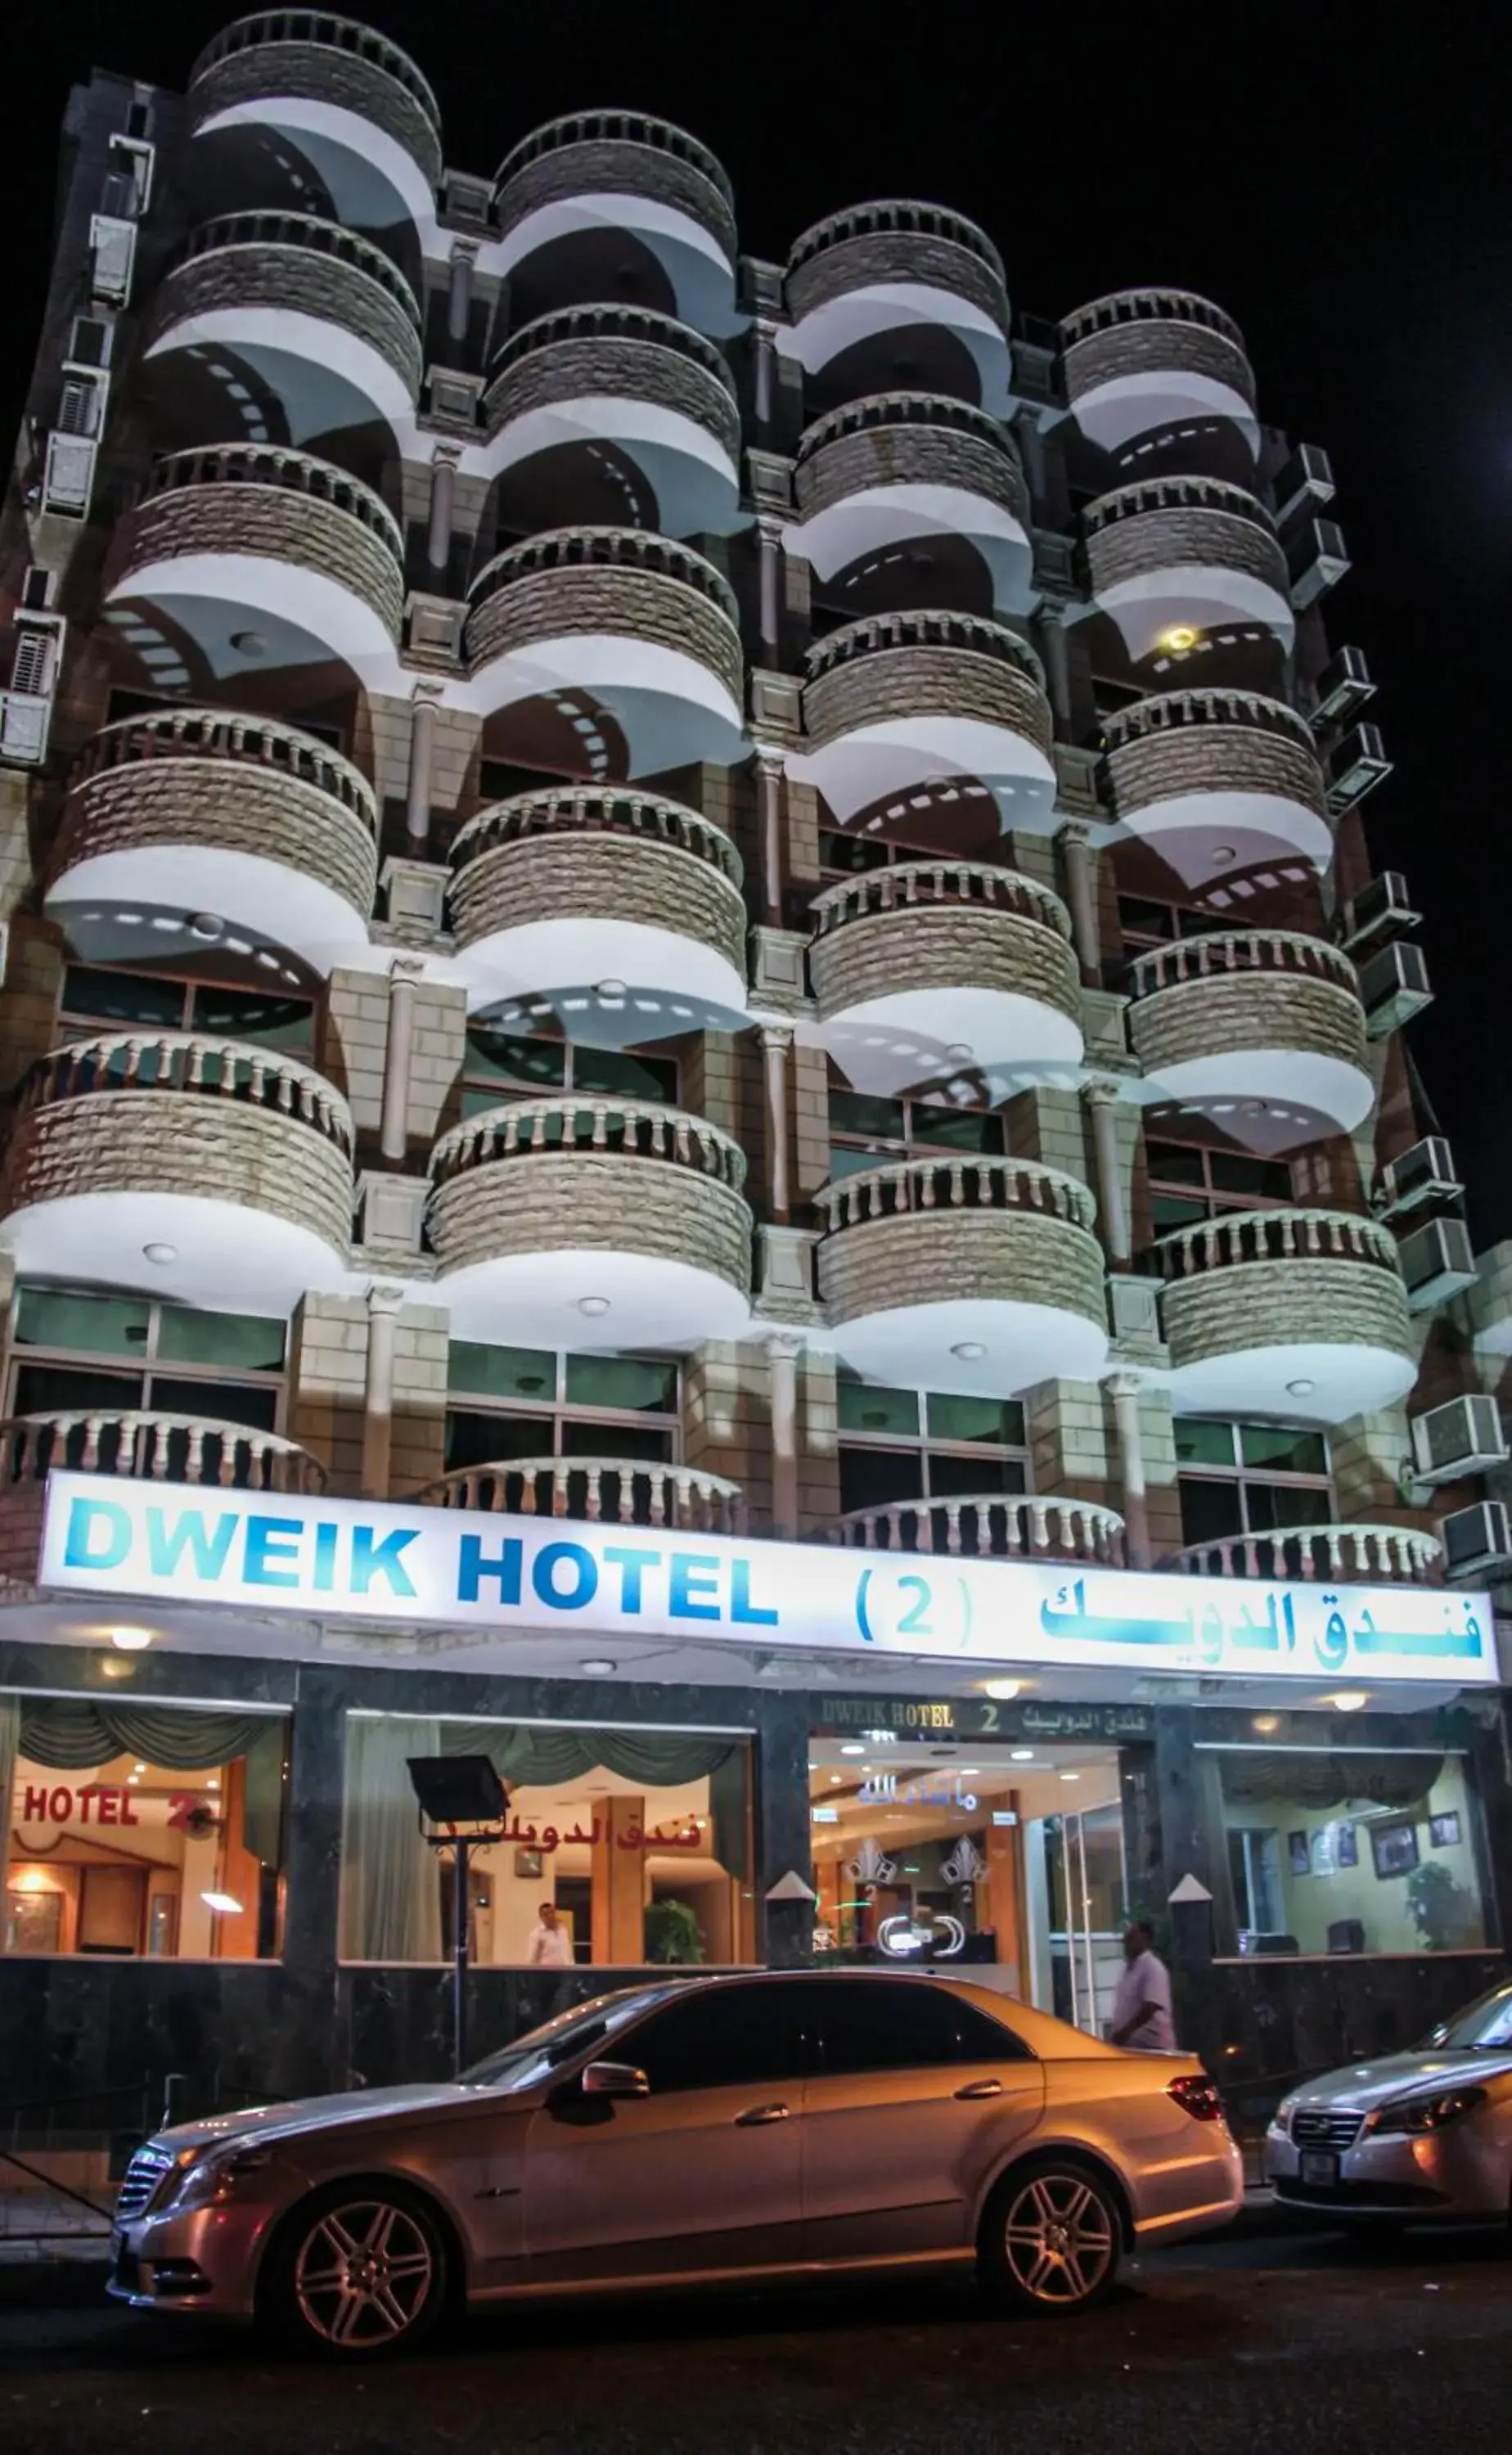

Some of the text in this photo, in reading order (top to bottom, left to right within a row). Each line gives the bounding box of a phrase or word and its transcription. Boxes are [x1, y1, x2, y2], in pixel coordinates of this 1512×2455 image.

[64, 1496, 421, 1598] DWEIK
[457, 1534, 780, 1626] HOTEL
[1040, 1578, 1483, 1671] فندق الدويك
[823, 1699, 1001, 1732] DWEIK HOTEL 2
[1105, 1709, 1148, 1735] فندق
[24, 1786, 139, 1827] HOTEL
[617, 1813, 701, 1850] فندق
